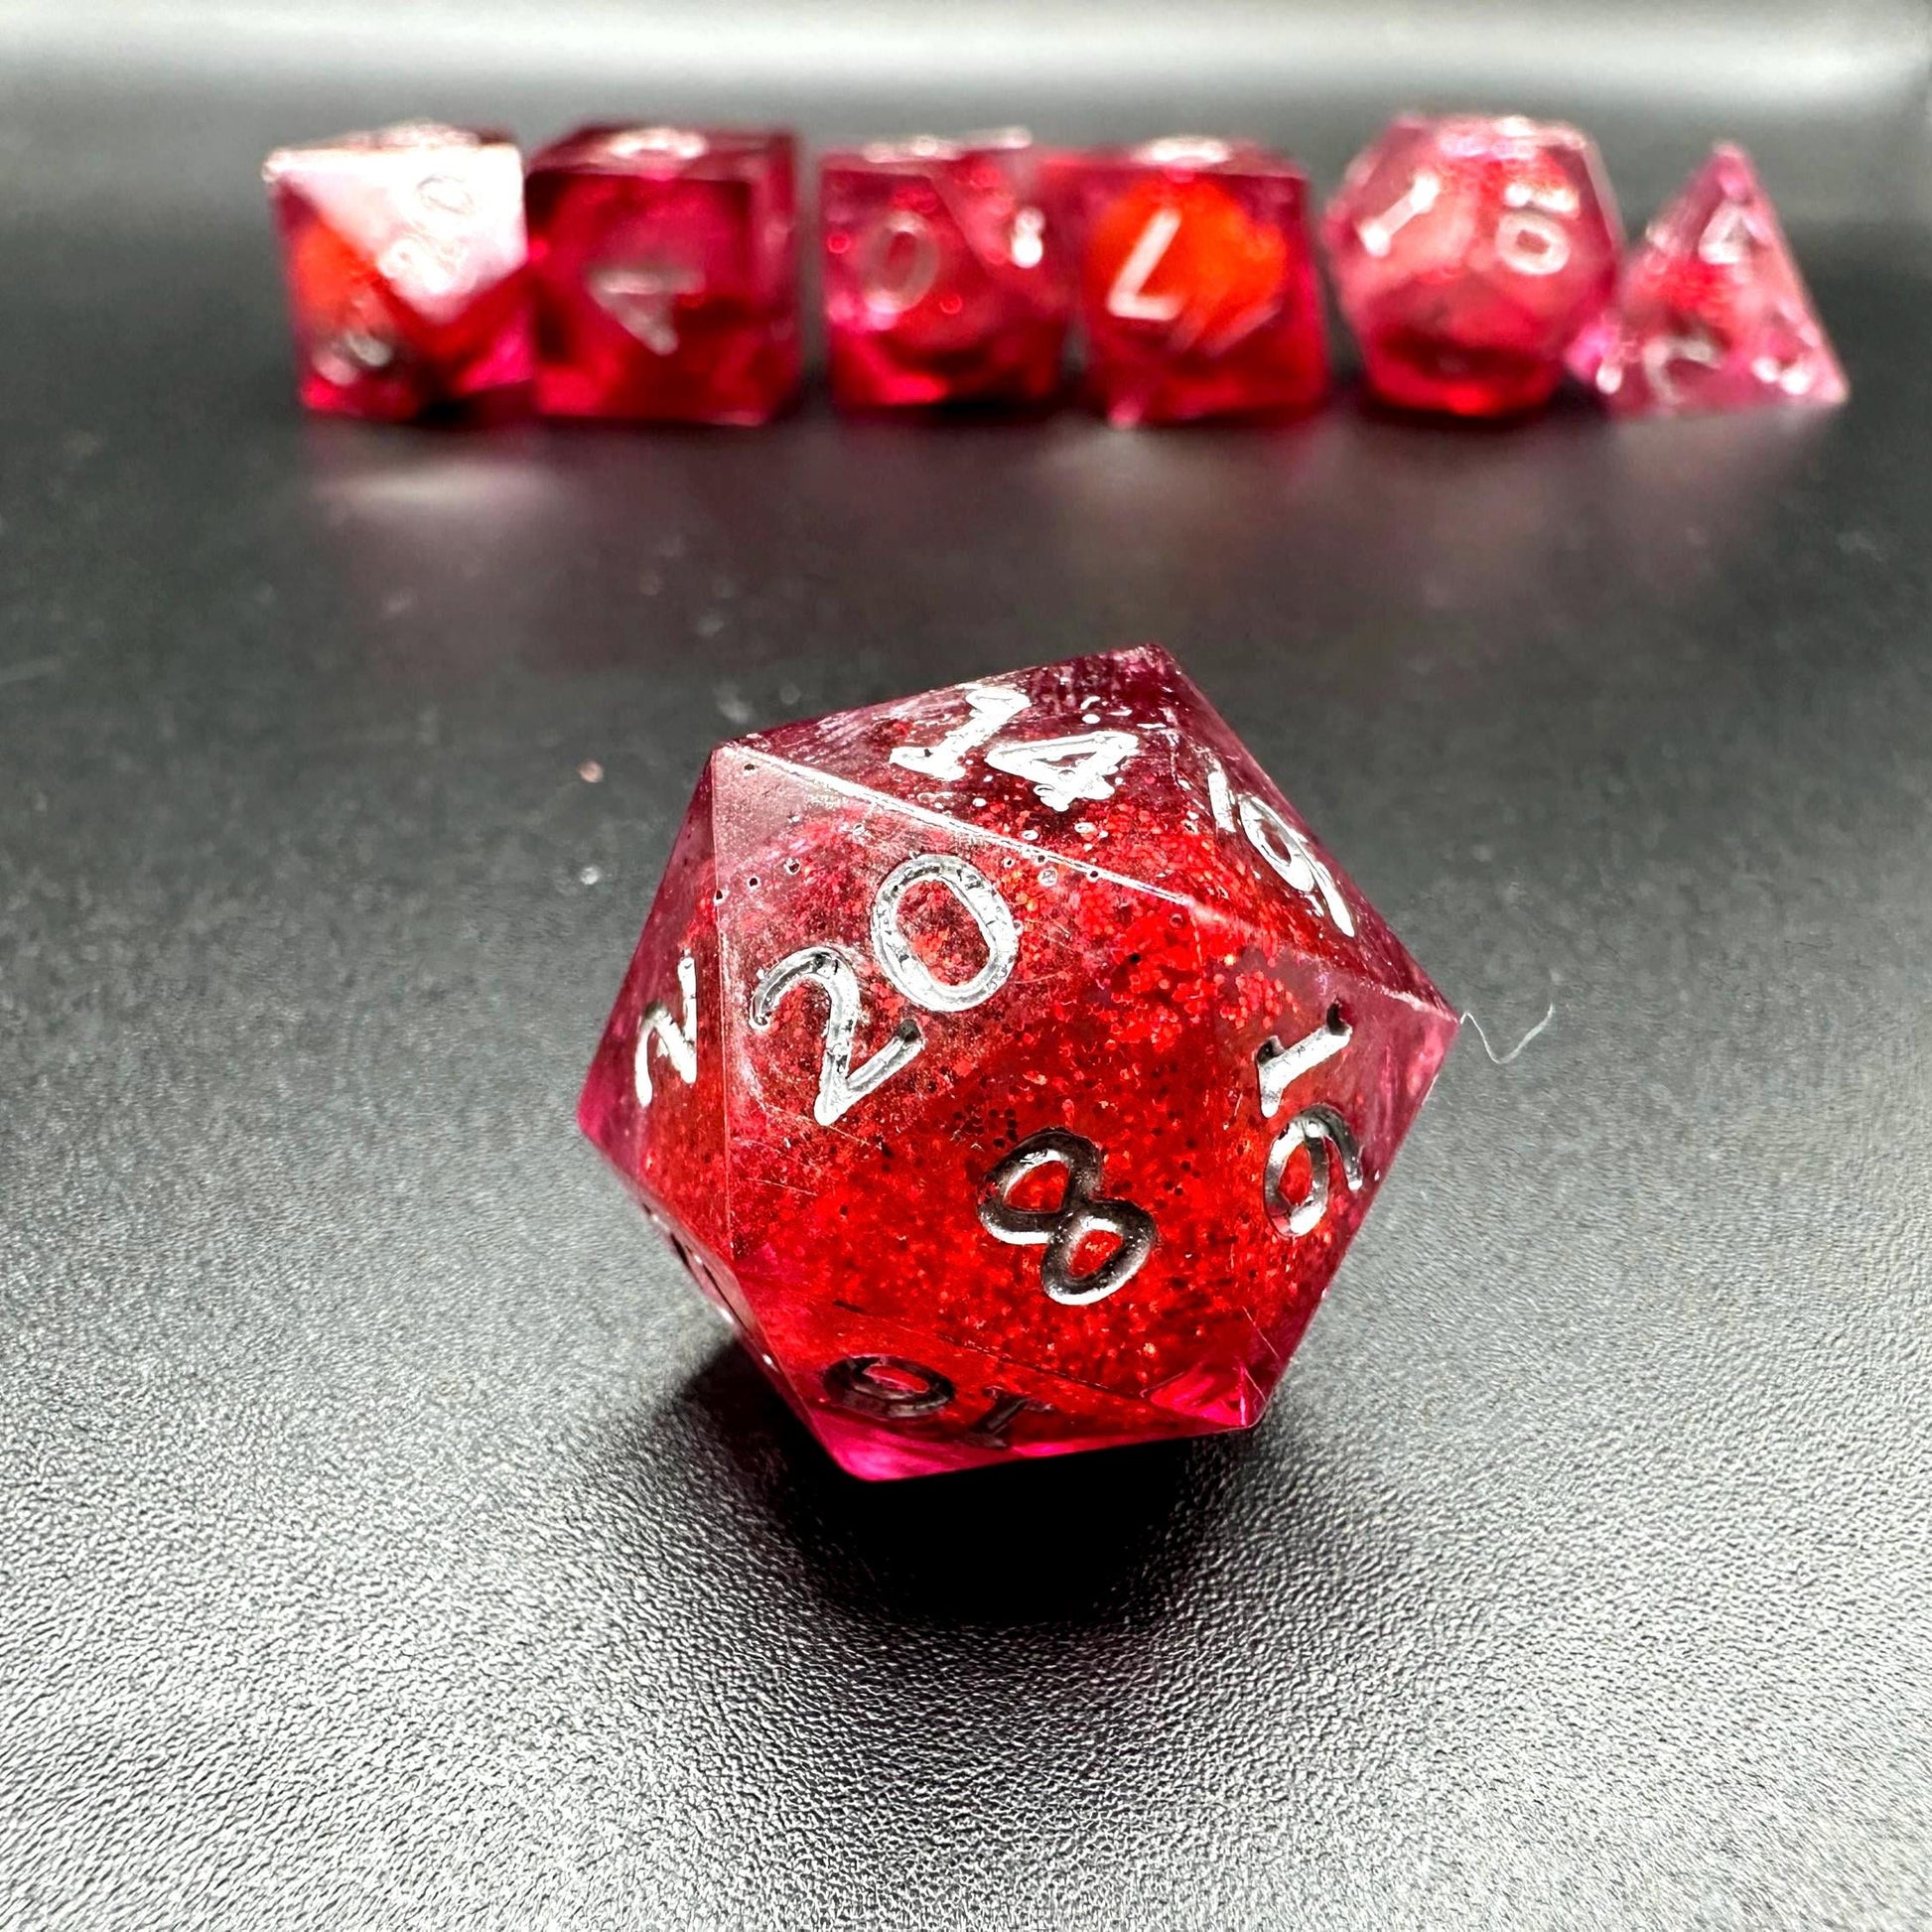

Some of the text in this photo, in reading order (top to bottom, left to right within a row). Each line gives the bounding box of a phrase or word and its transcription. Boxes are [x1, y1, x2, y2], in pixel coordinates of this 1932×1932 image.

[889, 687, 1140, 812] 14
[633, 953, 697, 1108] 2
[748, 853, 1021, 1127] 20
[976, 1126, 1158, 1306] 8
